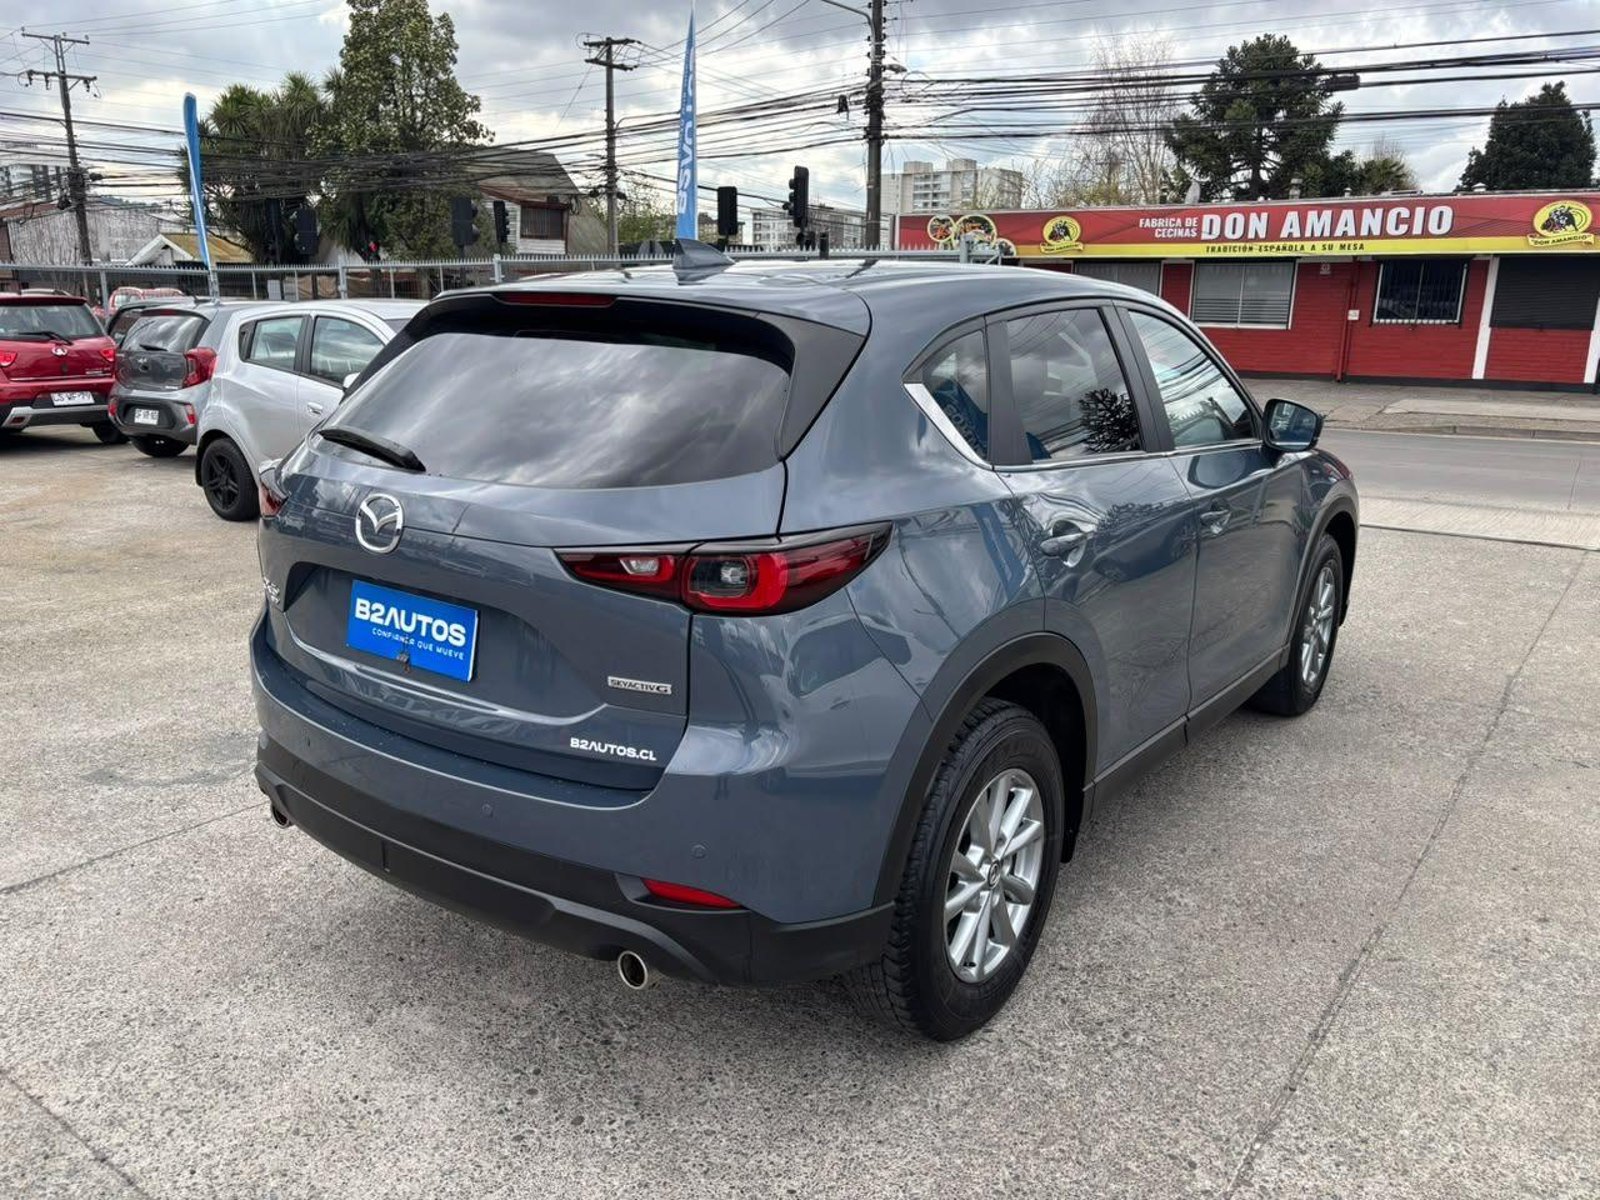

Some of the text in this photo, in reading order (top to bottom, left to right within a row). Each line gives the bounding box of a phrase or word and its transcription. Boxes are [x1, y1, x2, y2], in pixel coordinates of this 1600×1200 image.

[1154, 228, 1198, 238] CECINAS
[1185, 217, 1199, 228] DE
[1201, 205, 1453, 240] DON AMANCIO
[1206, 244, 1254, 253] TRADICIÓN
[1258, 243, 1305, 252] ESPAÑOLA
[1321, 243, 1334, 251] SU
[1339, 243, 1365, 251] MESA
[355, 597, 467, 648] B2AUTOS
[417, 640, 434, 651] QUE
[435, 646, 464, 661] MUEVE
[570, 737, 657, 761] B2AUTOS.CL
